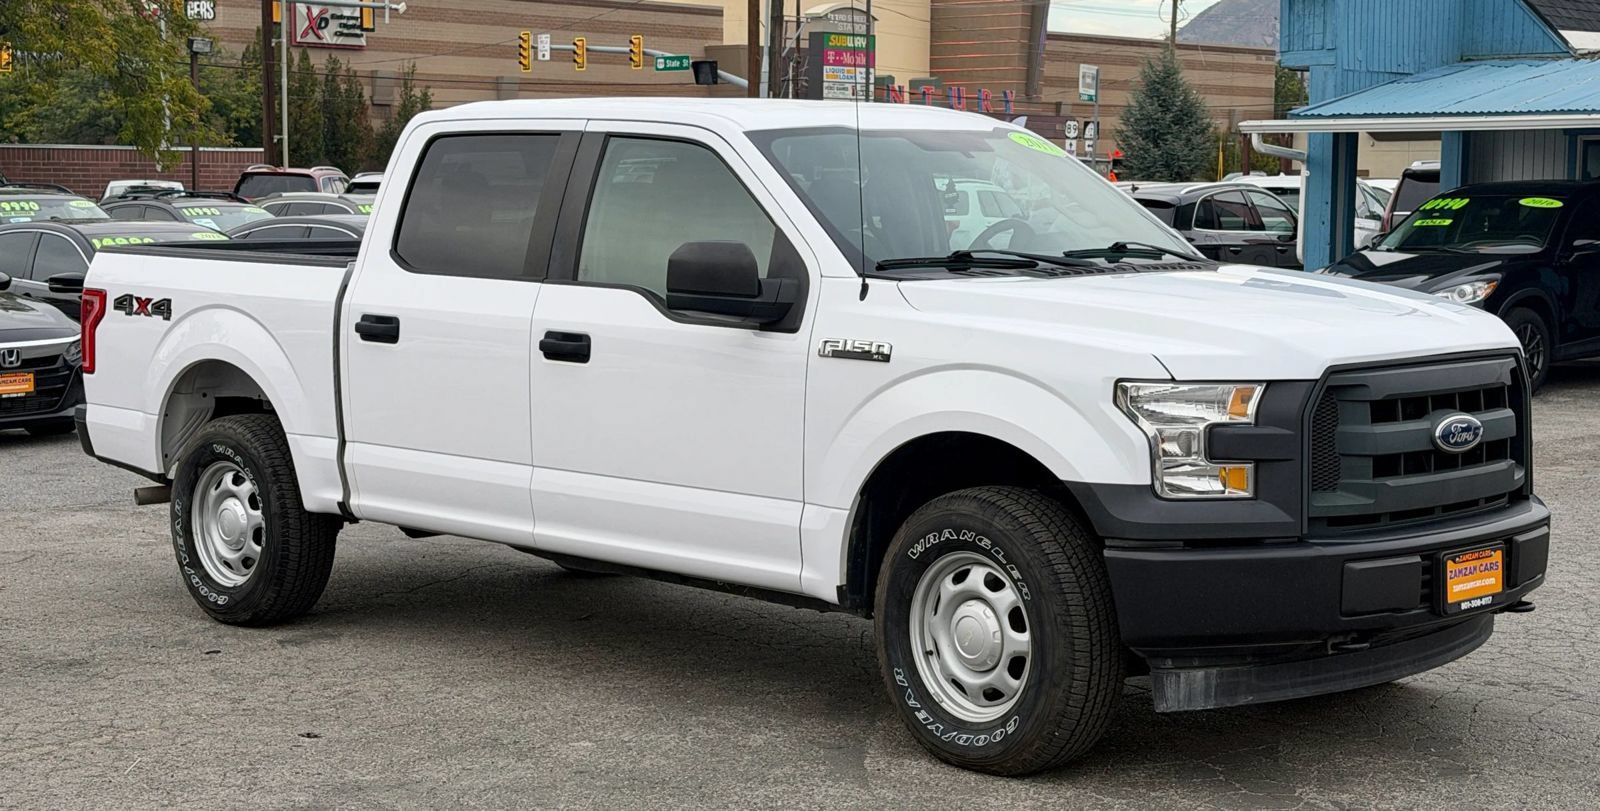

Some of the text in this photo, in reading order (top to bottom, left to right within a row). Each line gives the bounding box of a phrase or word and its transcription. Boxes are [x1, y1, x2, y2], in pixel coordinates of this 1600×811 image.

[829, 34, 867, 48] SUBWAY
[666, 59, 680, 67] State
[1066, 123, 1078, 134] 89
[1449, 423, 1475, 444] Ford
[1459, 549, 1492, 562] ZAMZAM CARS
[907, 528, 1032, 601] WRANGLER
[1449, 560, 1499, 580] ZAMZAM CARS
[893, 667, 1020, 747] GOODYEAR
